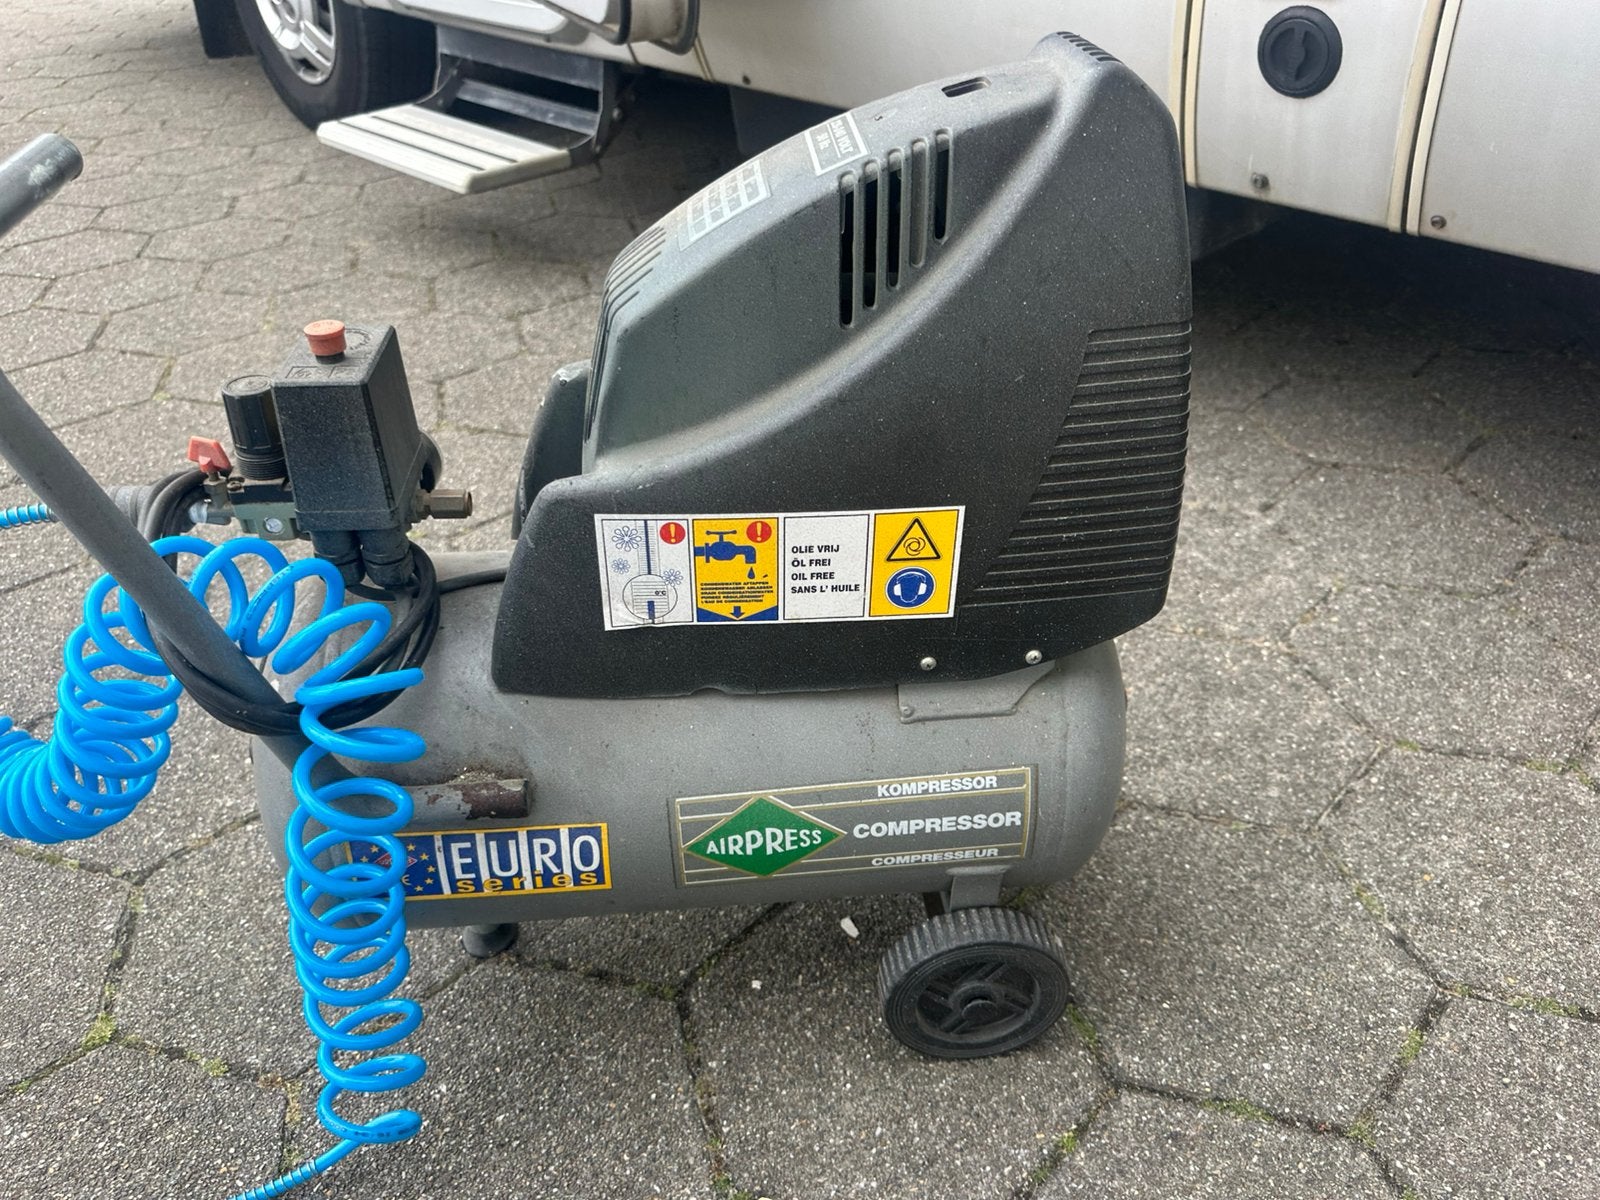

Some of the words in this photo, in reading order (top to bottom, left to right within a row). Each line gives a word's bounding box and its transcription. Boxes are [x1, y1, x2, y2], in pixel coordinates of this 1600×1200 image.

[817, 544, 840, 552] VRIJ
[791, 557, 806, 567] ÖL
[809, 558, 831, 566] FREI
[791, 572, 807, 580] OIL
[810, 572, 835, 580] FREE
[791, 585, 817, 594] SANS
[831, 584, 860, 592] HUILE
[877, 775, 997, 797] KOMPRESSOR
[853, 811, 1022, 838] COMPRESSOR
[706, 827, 822, 855] AIRPRESS
[451, 835, 600, 879] EURO
[871, 848, 999, 866] COMPRESSEUR
[456, 870, 598, 893] series
